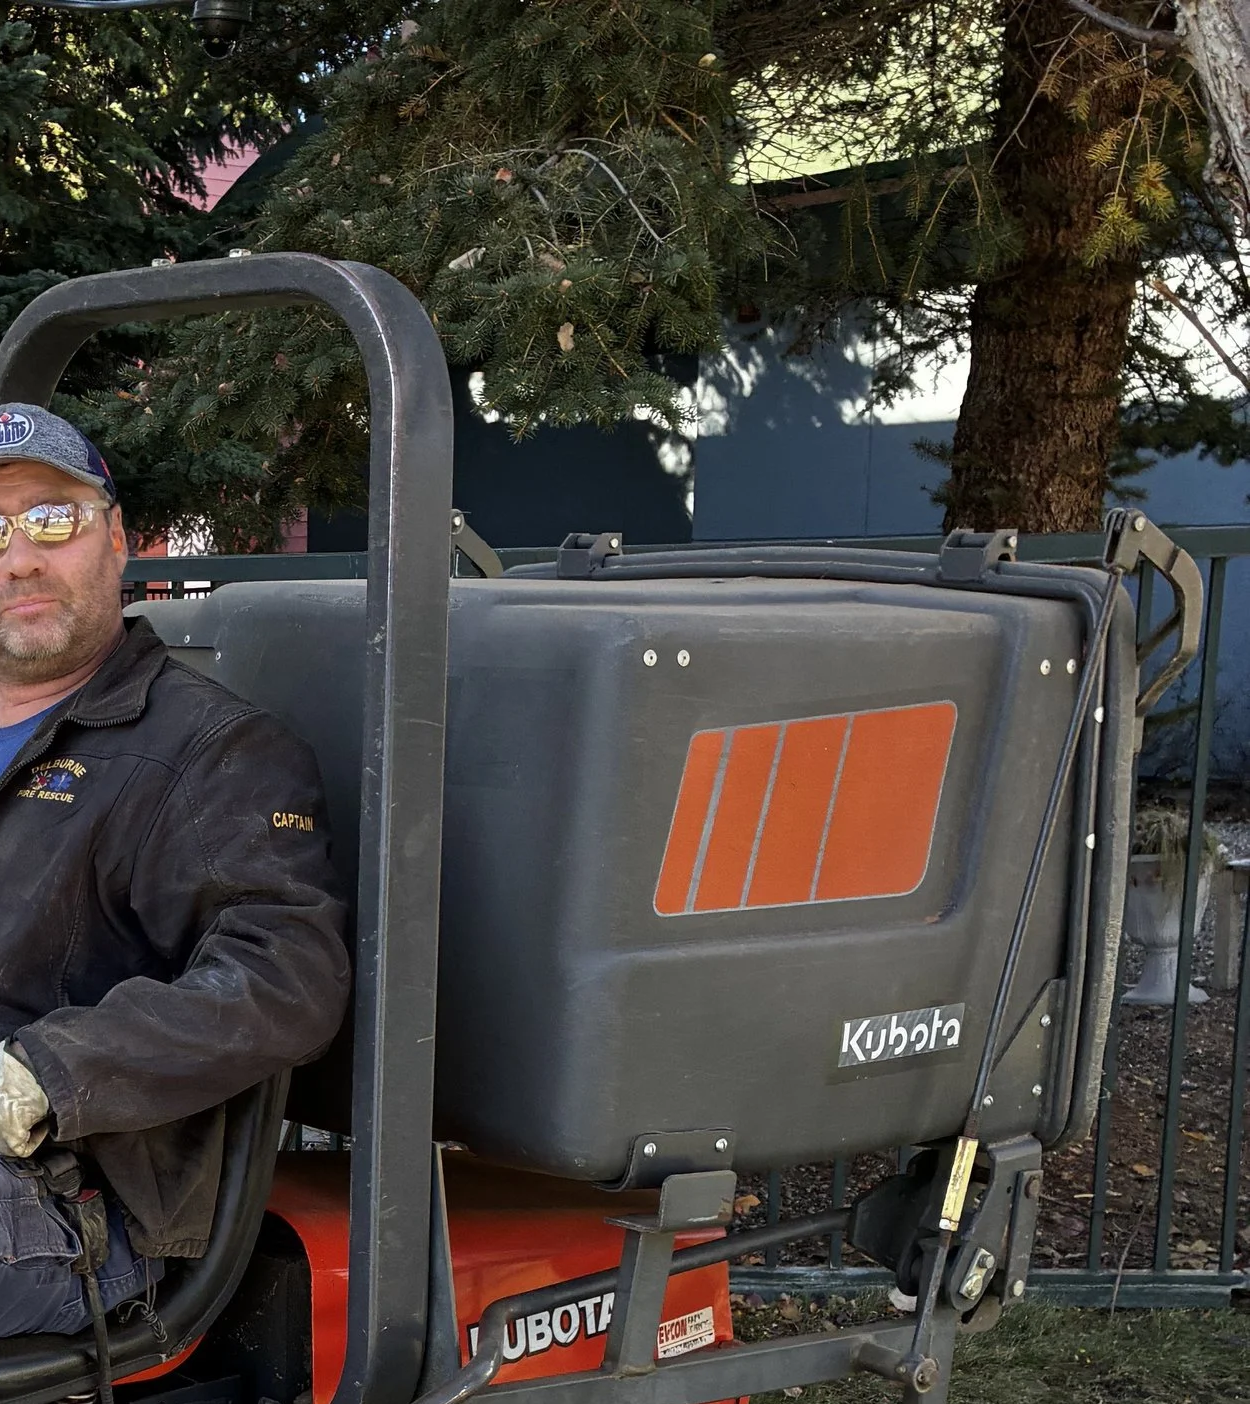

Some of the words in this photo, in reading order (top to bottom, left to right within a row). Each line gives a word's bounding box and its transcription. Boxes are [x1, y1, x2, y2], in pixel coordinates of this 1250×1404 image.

[31, 758, 87, 778] DELBURNE
[37, 790, 75, 803] RESCUE
[273, 812, 314, 832] CAPTAIN
[841, 1008, 961, 1062] Kubota
